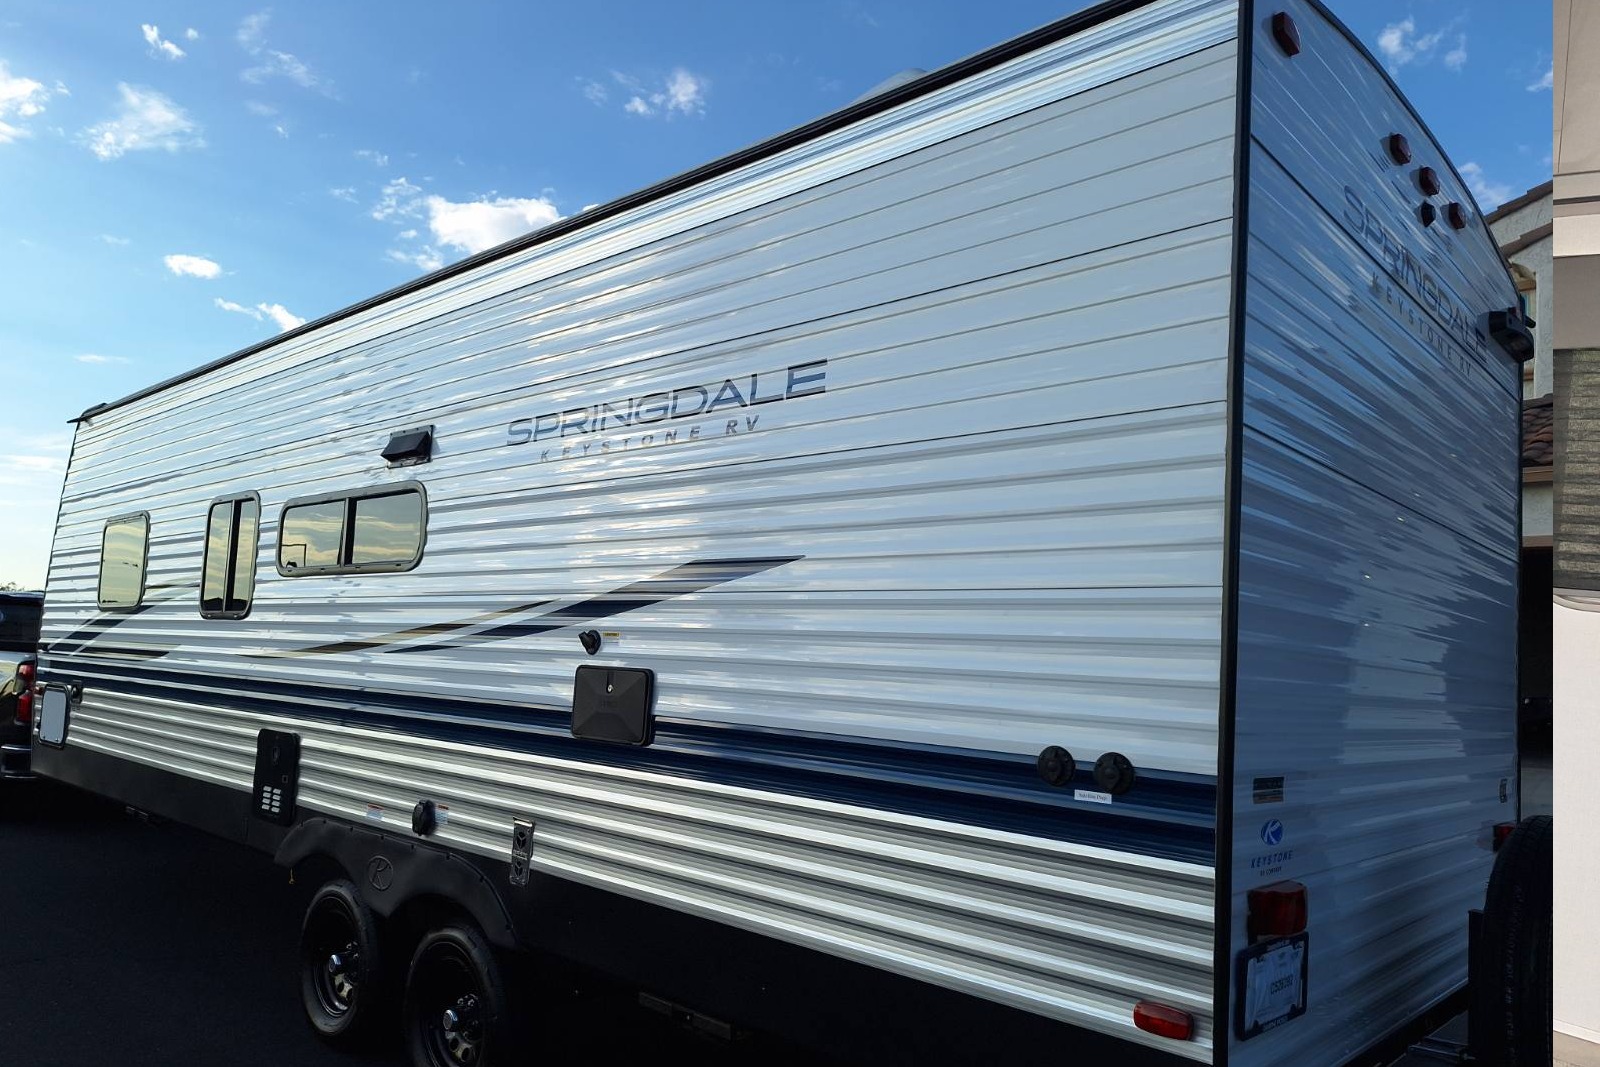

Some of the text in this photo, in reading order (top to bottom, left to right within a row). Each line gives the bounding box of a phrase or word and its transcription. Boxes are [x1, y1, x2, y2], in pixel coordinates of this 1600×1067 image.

[1344, 185, 1488, 365] SPRINGDALE
[1372, 271, 1453, 360] KEYSTONE
[507, 359, 828, 446] SPRINGDALE
[540, 414, 760, 463] KEYSTONE RV
[1250, 850, 1293, 869] KEYSTONE
